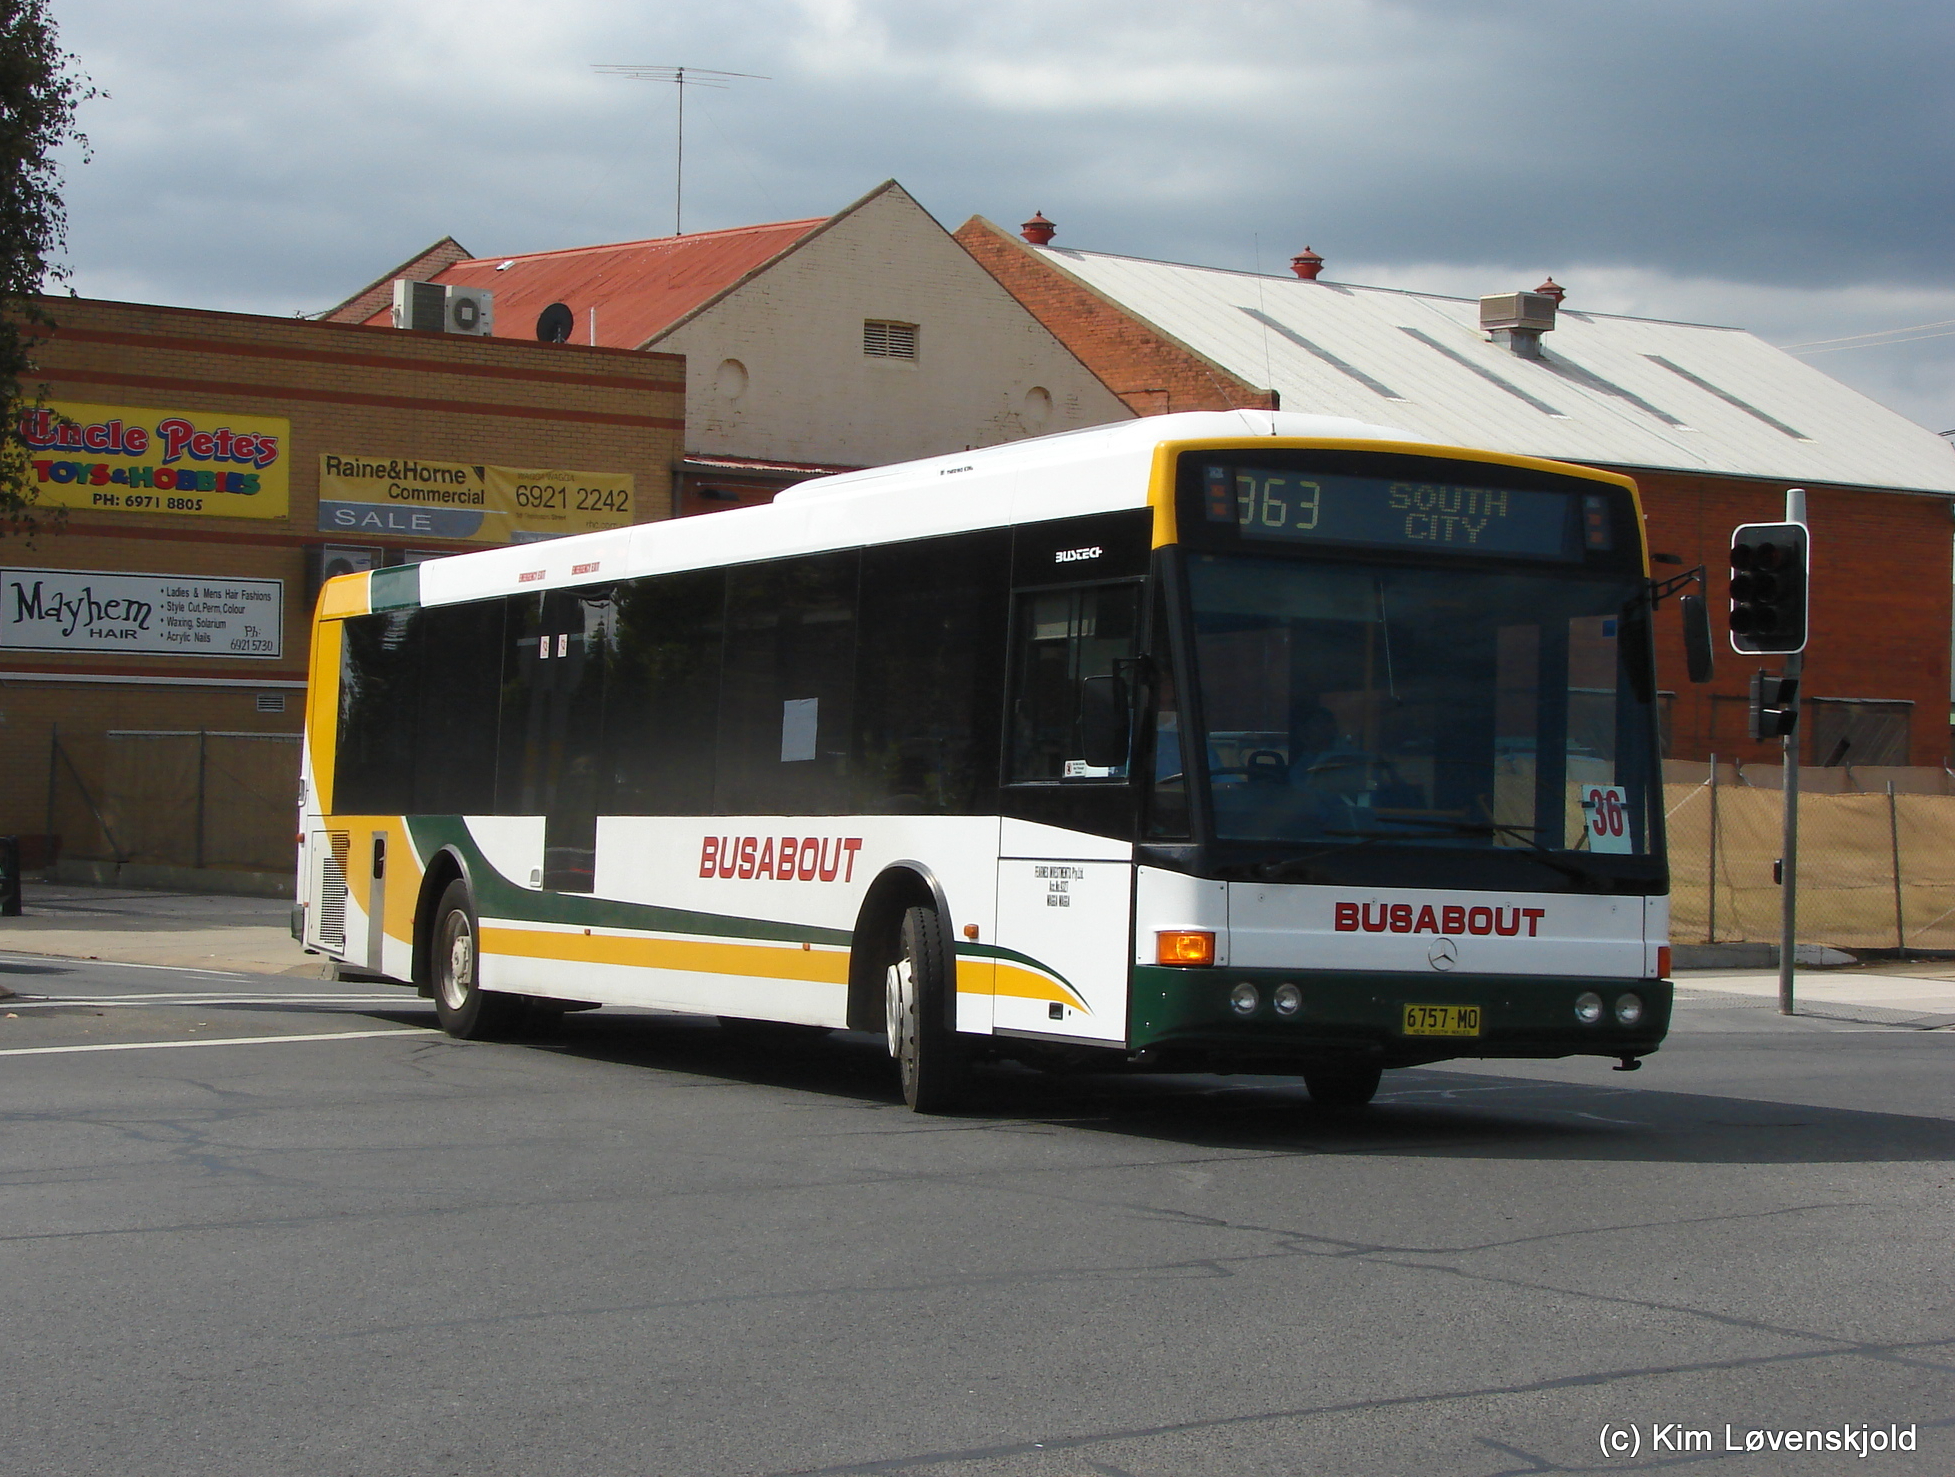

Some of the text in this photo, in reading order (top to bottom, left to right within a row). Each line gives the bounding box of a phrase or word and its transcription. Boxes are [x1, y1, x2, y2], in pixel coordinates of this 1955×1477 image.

[20, 407, 278, 468] Uncle Pete's
[93, 493, 203, 511] PH: 6971 8805
[388, 483, 485, 505] Commercial
[516, 485, 629, 512] 6921 2242
[1389, 483, 1508, 517] SOUTH
[334, 509, 432, 531] SALE
[1405, 513, 1488, 543] CITY
[167, 587, 271, 602] Ladies & Mens Hair Fashions
[11, 581, 152, 637] Mayhem
[167, 601, 185, 614] Style
[90, 628, 138, 640] HAIR
[196, 617, 226, 629] Solarium
[244, 625, 262, 638] Ph:
[167, 631, 211, 644] Acrylic Nails
[1589, 789, 1624, 838] 36
[699, 836, 863, 883] BUSABOUT
[1335, 901, 1546, 938] BUSABOUT
